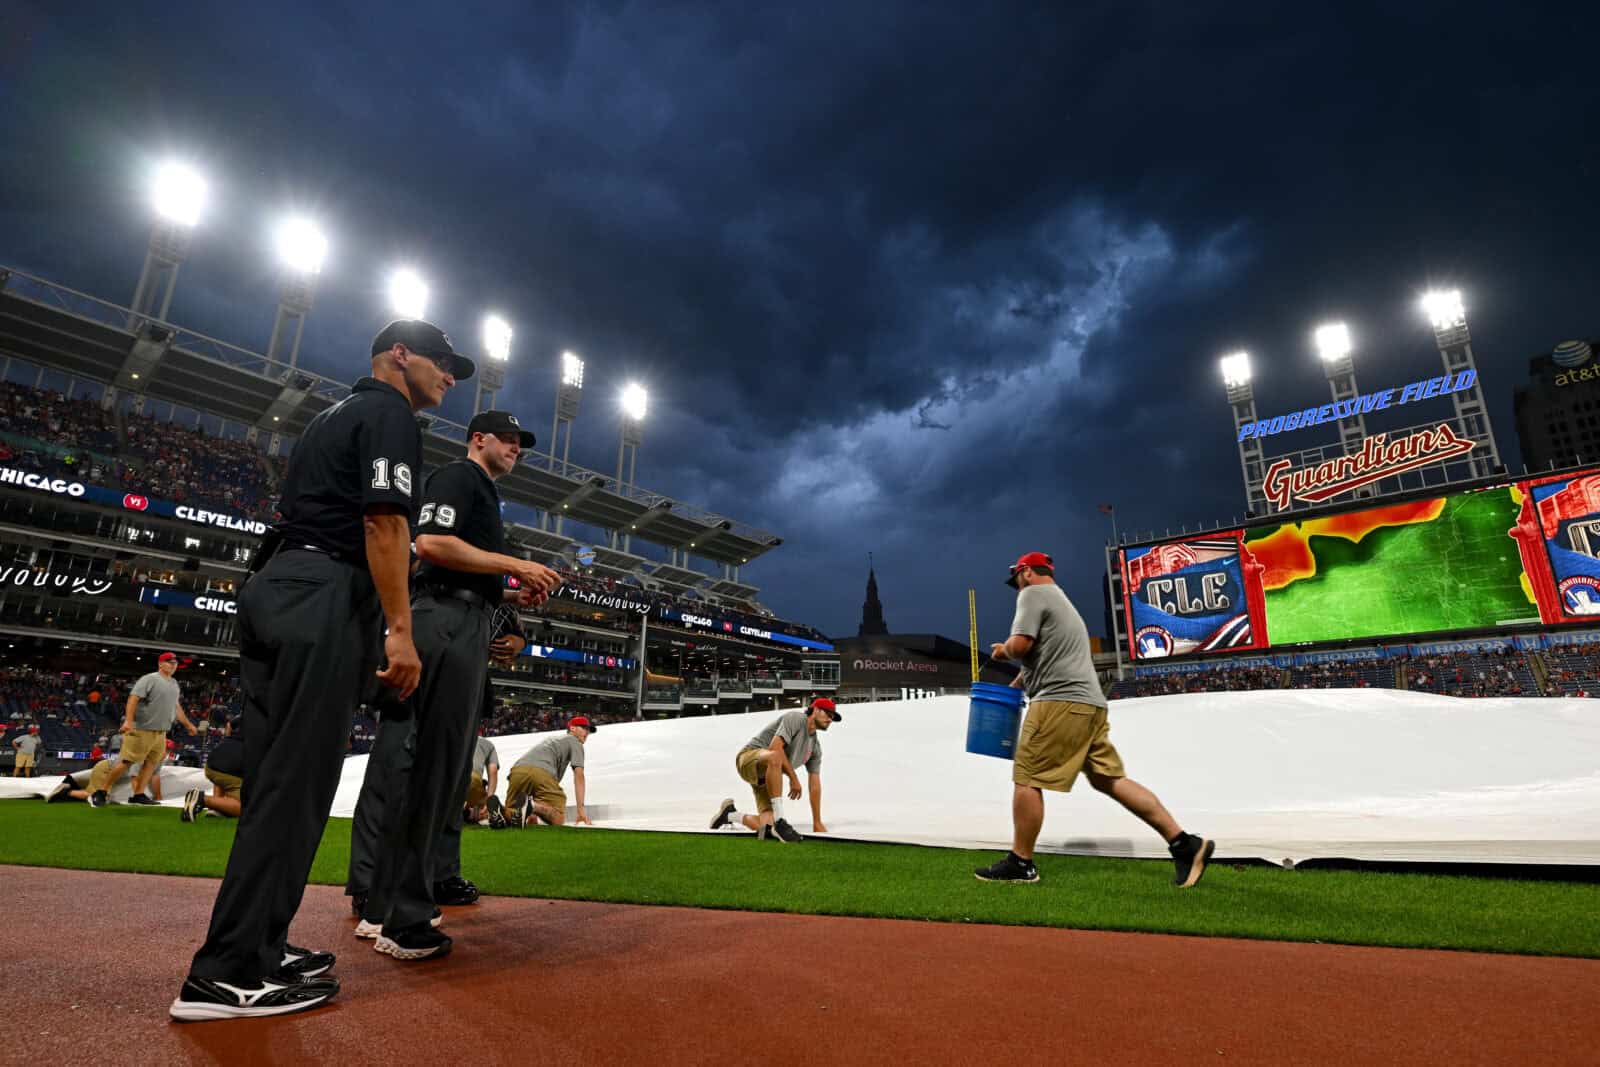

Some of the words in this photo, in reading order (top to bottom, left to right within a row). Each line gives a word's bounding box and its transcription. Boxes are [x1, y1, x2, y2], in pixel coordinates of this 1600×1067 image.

[1238, 388, 1394, 442] PROGRESSIVE
[1400, 368, 1477, 405] FIELD
[0, 467, 86, 496] HICAGO
[372, 457, 412, 497] 19
[1262, 423, 1477, 511] Guardians
[175, 505, 267, 535] CLEVELAND
[194, 596, 238, 615] CHIC
[1147, 572, 1230, 616] CLE
[681, 613, 712, 627] CHICAGO
[864, 659, 904, 671] Rocket
[907, 660, 938, 673] Arena
[1152, 664, 1201, 675] HONDA
